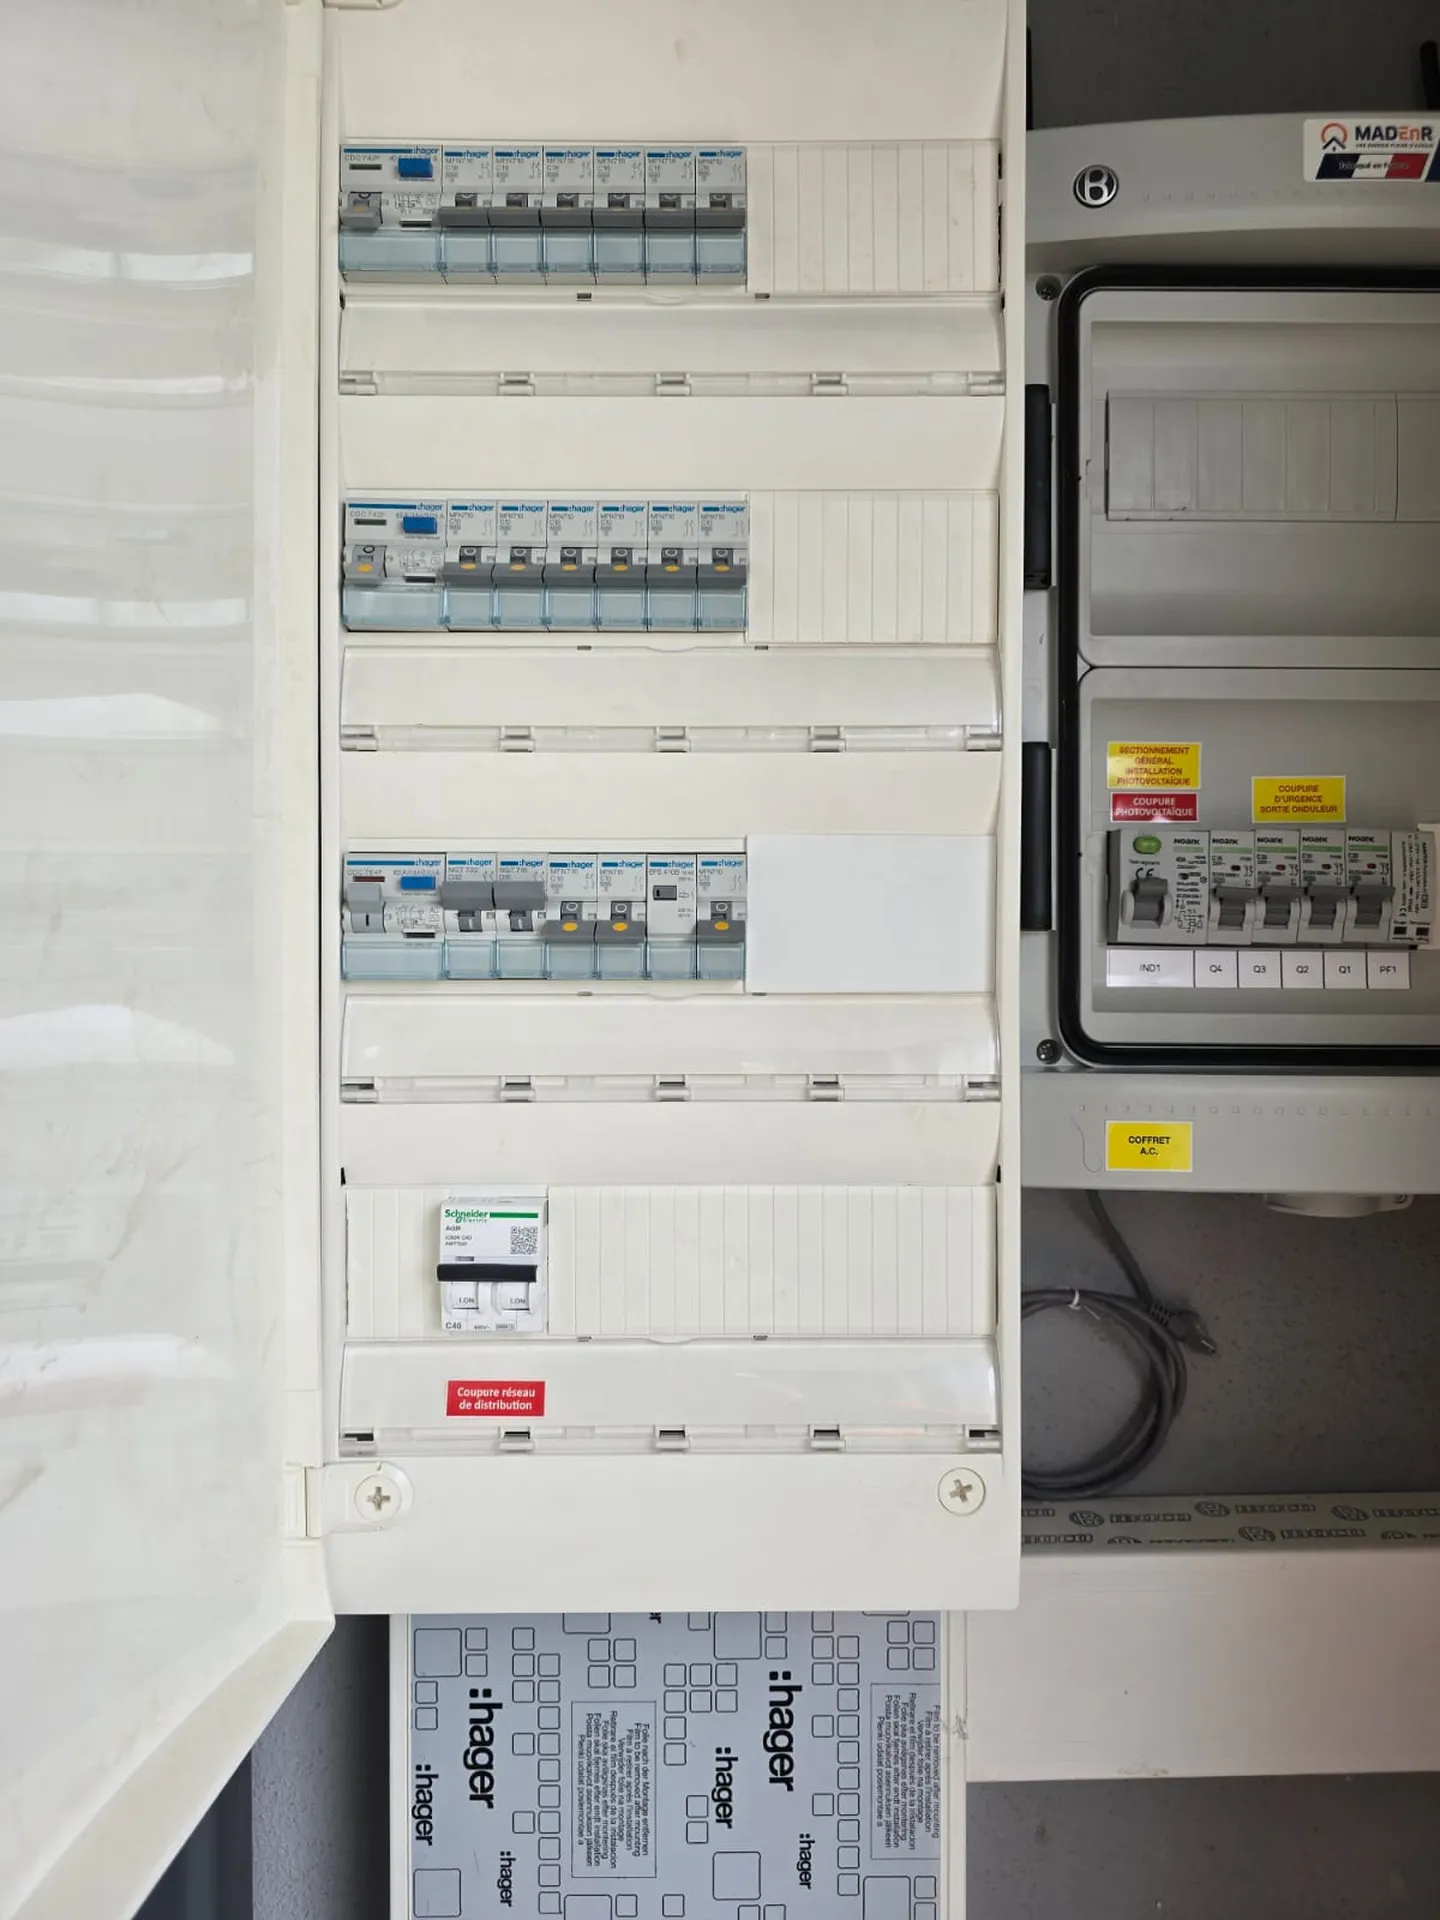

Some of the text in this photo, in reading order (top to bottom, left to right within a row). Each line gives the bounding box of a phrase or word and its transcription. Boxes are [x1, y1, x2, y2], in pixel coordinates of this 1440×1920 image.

[1119, 746, 1190, 754] SECTIONNEMENT
[1135, 756, 1173, 765] GÉNÉRAL
[1125, 766, 1182, 775] INSTALLATION
[1116, 776, 1191, 786] PHOTOVOLTAÏQUE
[1278, 784, 1319, 793] COUPURE
[1133, 797, 1176, 806] COUPURE
[1274, 794, 1322, 803] D'URGENCE
[1115, 806, 1194, 817] PHOTOVOLTAÏQUE
[1260, 805, 1337, 813] SORTIE ONDULEUR
[1140, 964, 1160, 972] IND1
[1210, 964, 1223, 973] Q4
[1253, 965, 1266, 973] Q3
[1338, 966, 1351, 974] Q1
[1128, 1136, 1171, 1144] COFFRET
[1140, 1147, 1159, 1155] A.C.
[444, 1209, 488, 1218] Schneider
[445, 1322, 462, 1330] C40
[457, 1387, 536, 1398] Coupure réseau
[459, 1399, 532, 1410] de distribution
